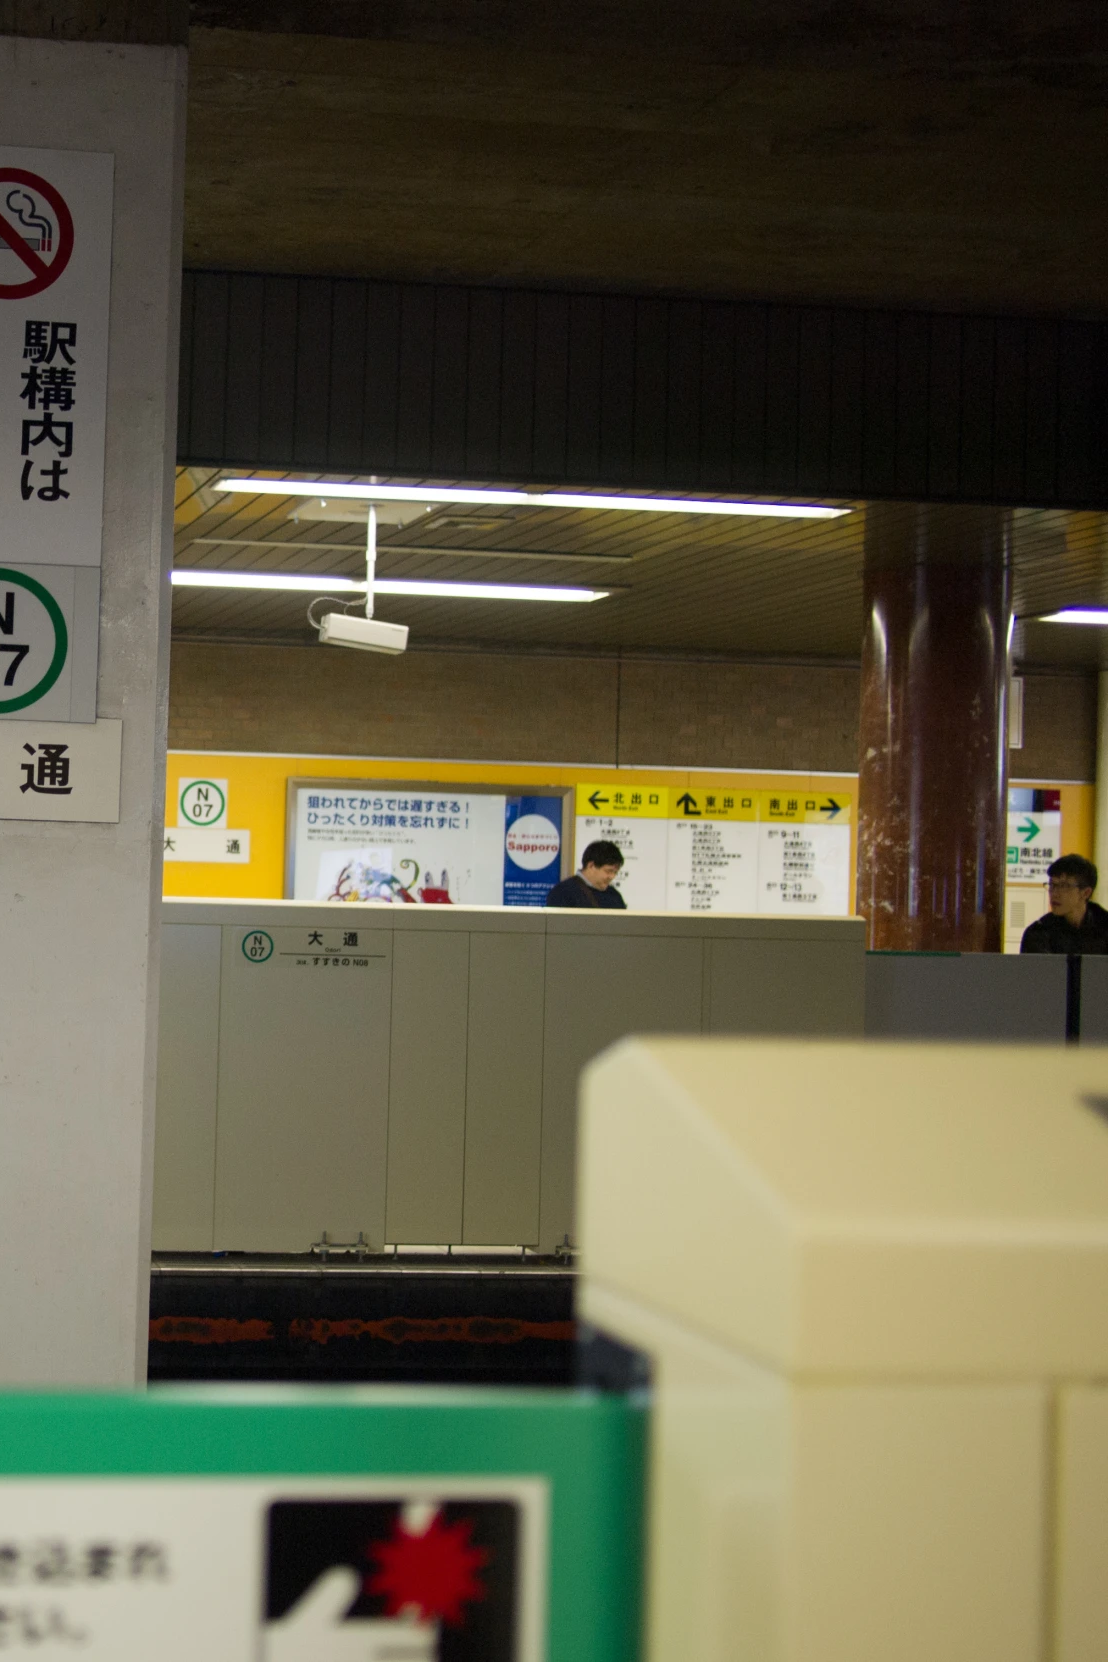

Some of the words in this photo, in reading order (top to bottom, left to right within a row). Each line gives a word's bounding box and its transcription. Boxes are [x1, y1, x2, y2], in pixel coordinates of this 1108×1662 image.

[19, 319, 77, 502] 駅構内は
[197, 787, 209, 802] N
[192, 803, 214, 818] 07
[508, 841, 558, 854] Sapporo
[253, 935, 263, 946] N
[250, 946, 265, 957] 07
